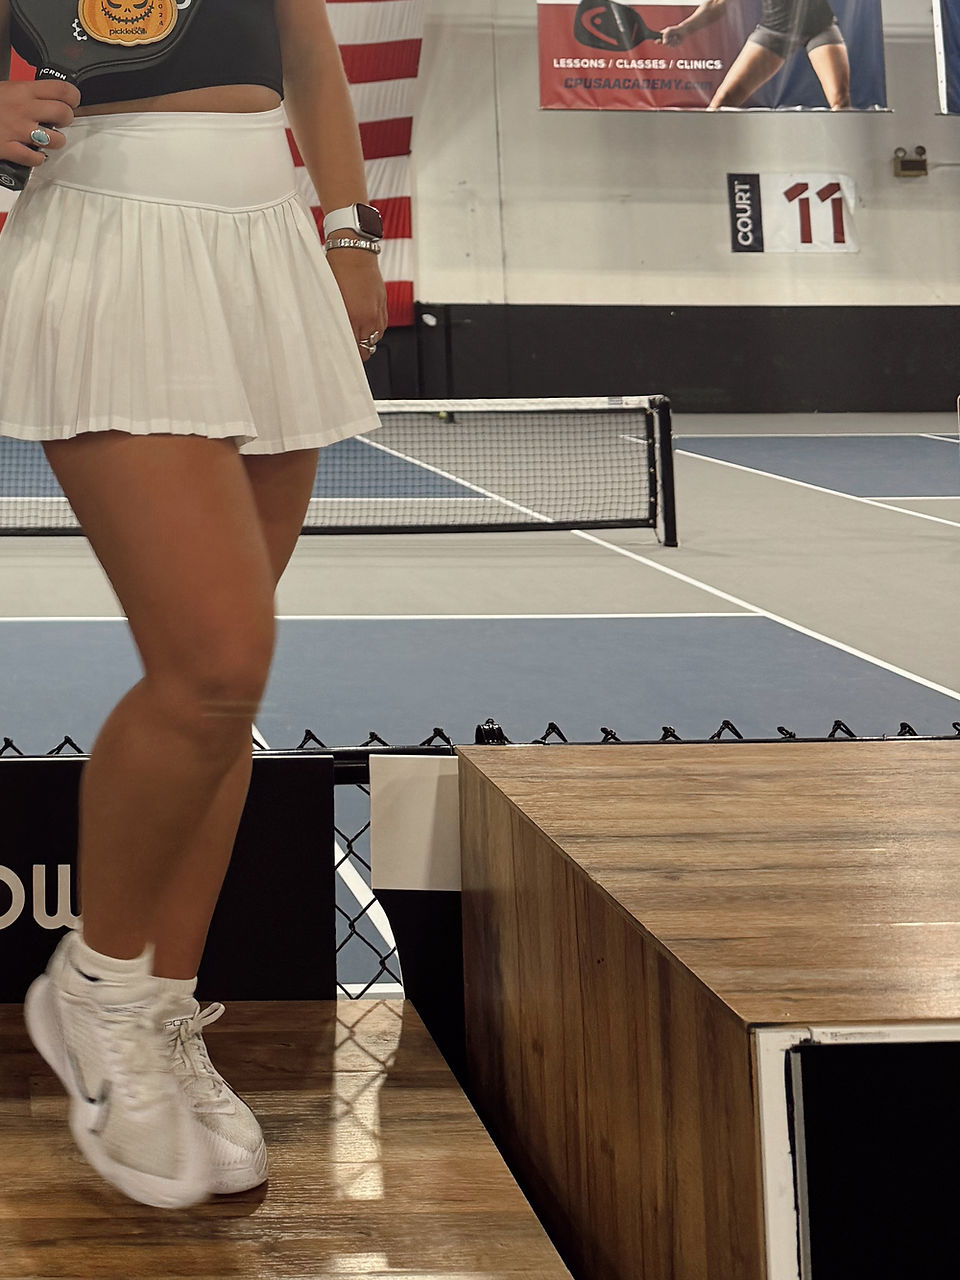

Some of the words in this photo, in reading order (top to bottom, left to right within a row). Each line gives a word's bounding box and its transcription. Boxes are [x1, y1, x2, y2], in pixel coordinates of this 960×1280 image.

[553, 58, 605, 68] LESSONS
[615, 59, 666, 69] CLASSES
[676, 59, 723, 70] CLINICS
[734, 181, 754, 246] COURT
[783, 182, 846, 244] 11
